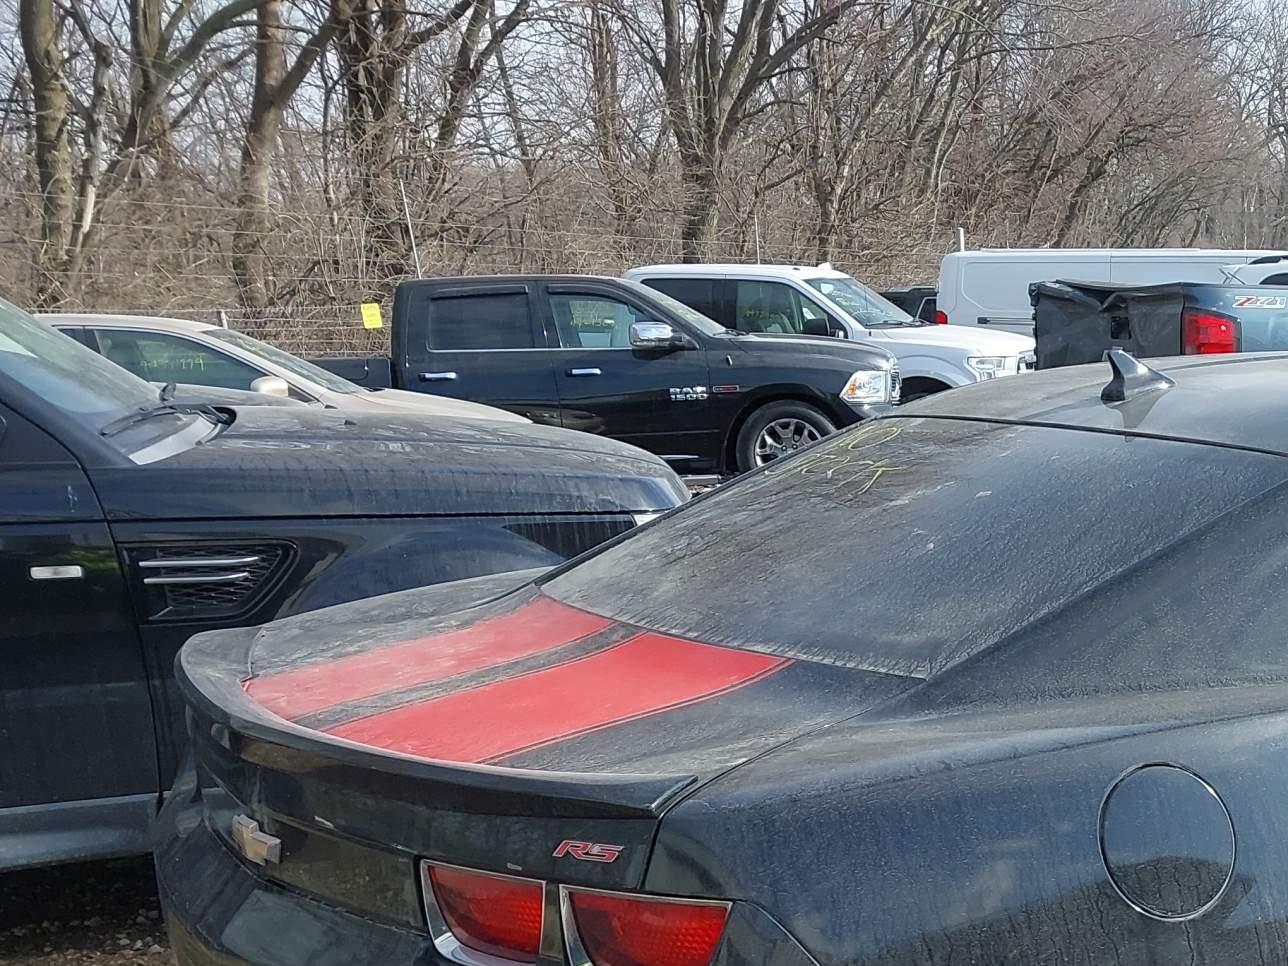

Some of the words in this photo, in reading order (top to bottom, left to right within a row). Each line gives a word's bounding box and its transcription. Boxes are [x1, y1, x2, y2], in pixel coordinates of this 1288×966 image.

[1232, 295, 1287, 309] Z71
[669, 386, 707, 394] RAM
[670, 393, 709, 401] 1500
[552, 840, 625, 863] RS
